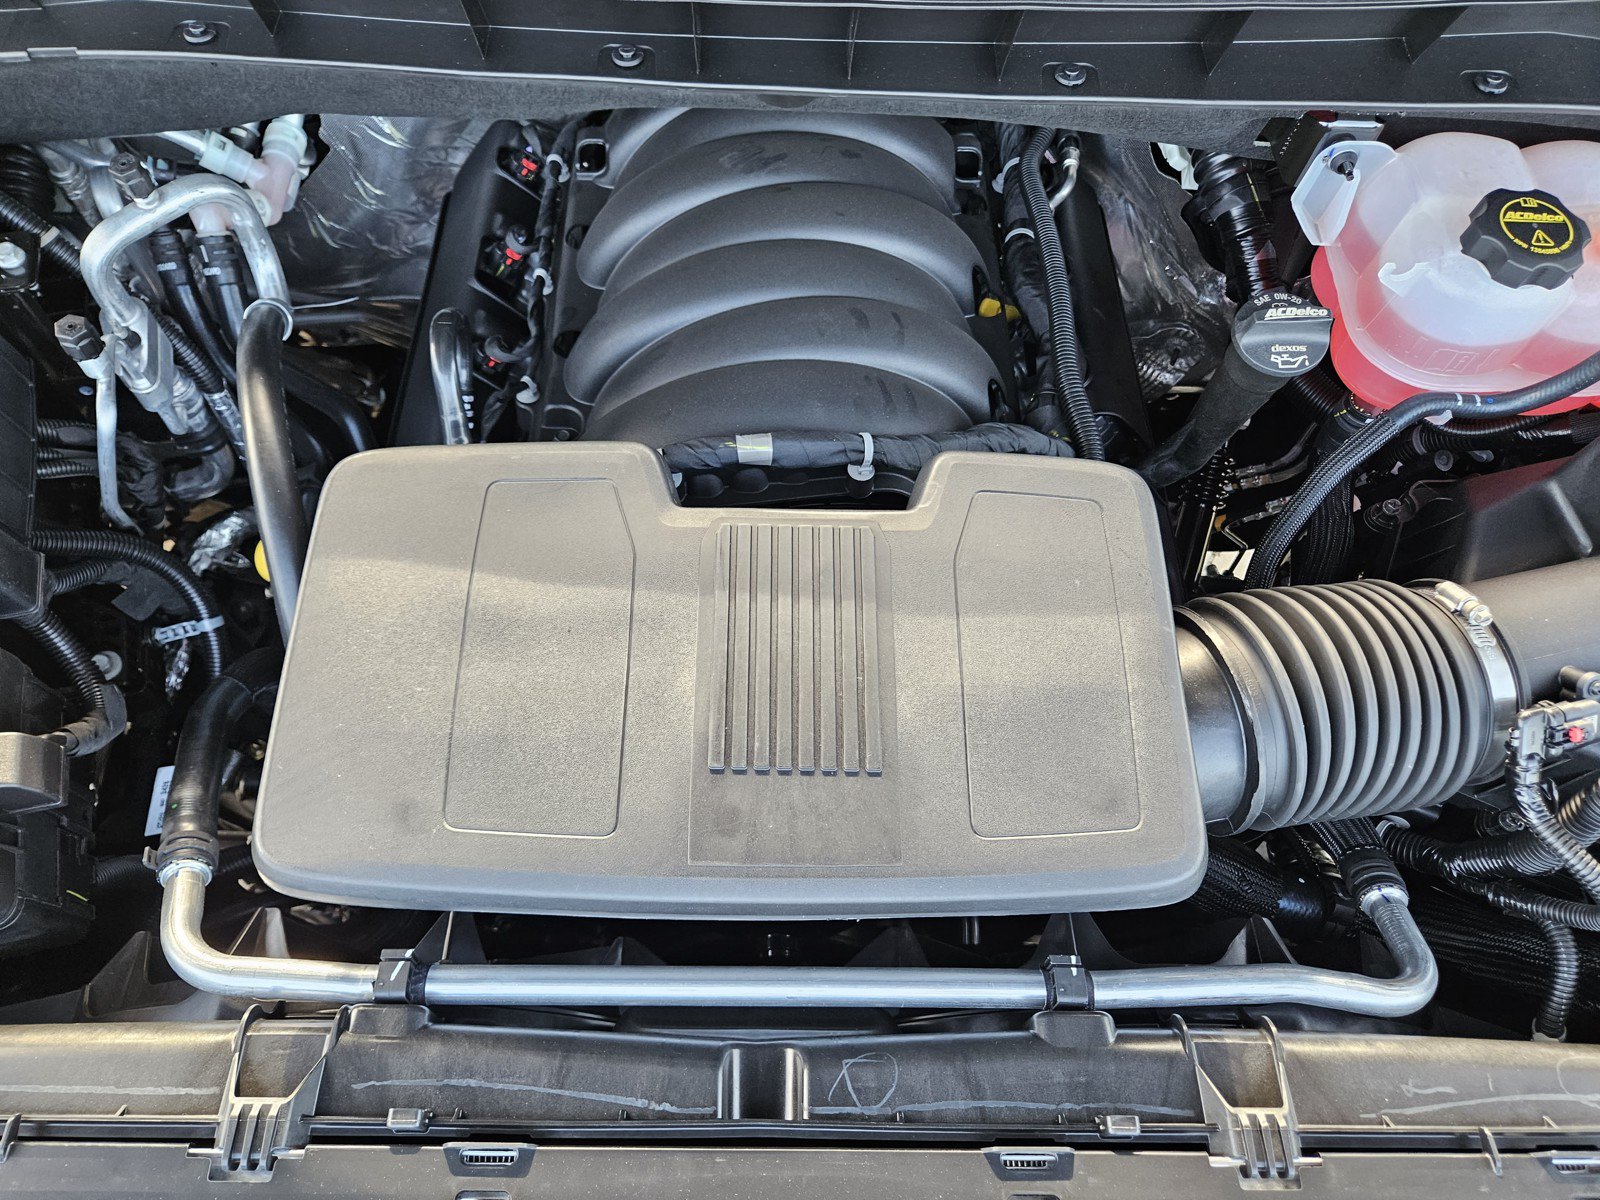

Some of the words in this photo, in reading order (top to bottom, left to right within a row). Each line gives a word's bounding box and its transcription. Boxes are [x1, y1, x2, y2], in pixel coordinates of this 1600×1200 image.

[1504, 211, 1565, 222] ACDelco
[1254, 294, 1271, 306] SAE
[1274, 293, 1302, 304] 0W-20
[1264, 307, 1329, 318] ACDelco
[1271, 344, 1307, 352] dexos
